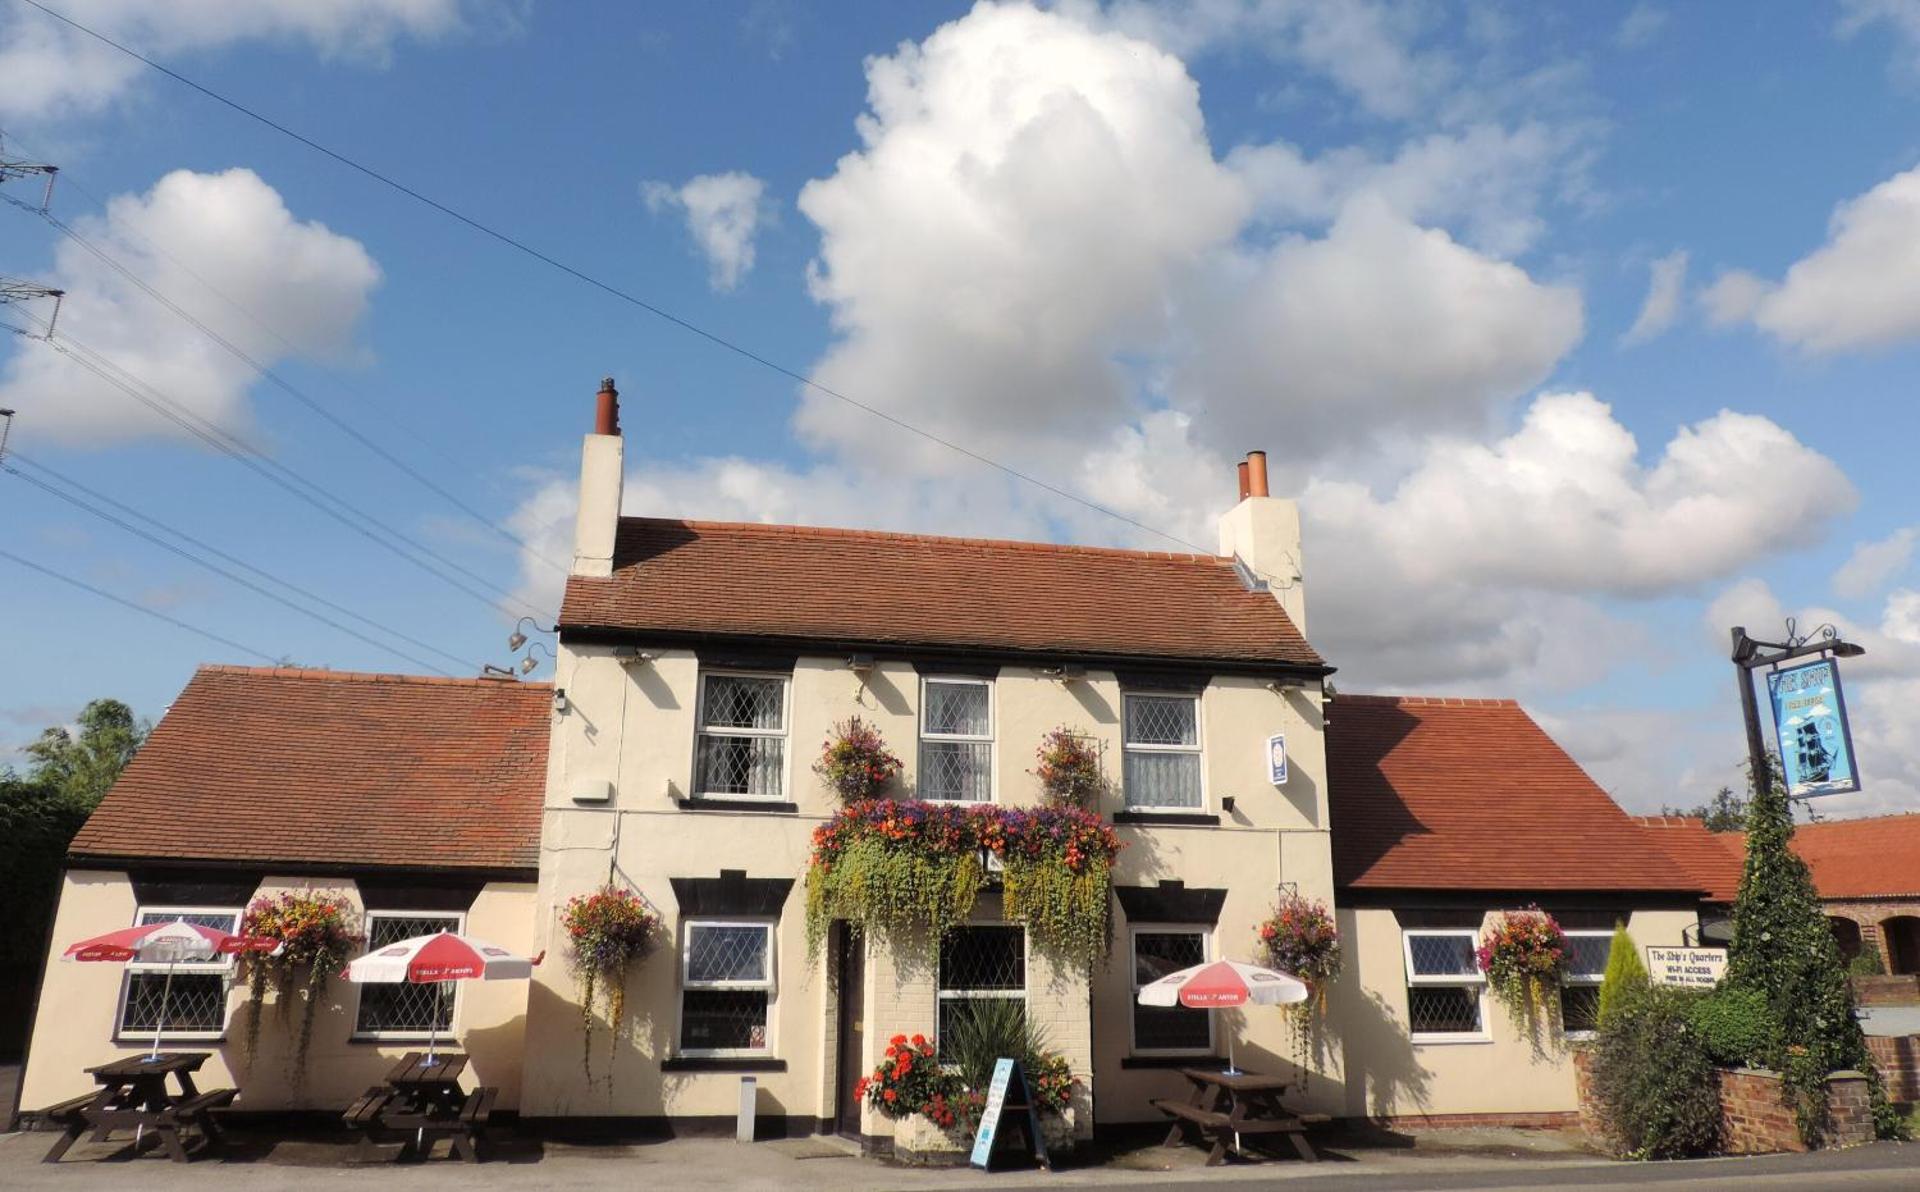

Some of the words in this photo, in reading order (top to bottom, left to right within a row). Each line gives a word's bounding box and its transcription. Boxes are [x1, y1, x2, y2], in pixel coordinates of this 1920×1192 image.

[1652, 950, 1665, 961] The
[1667, 951, 1687, 963] Ship's
[1689, 952, 1723, 965] Quarters
[1684, 966, 1712, 974] ACCESS
